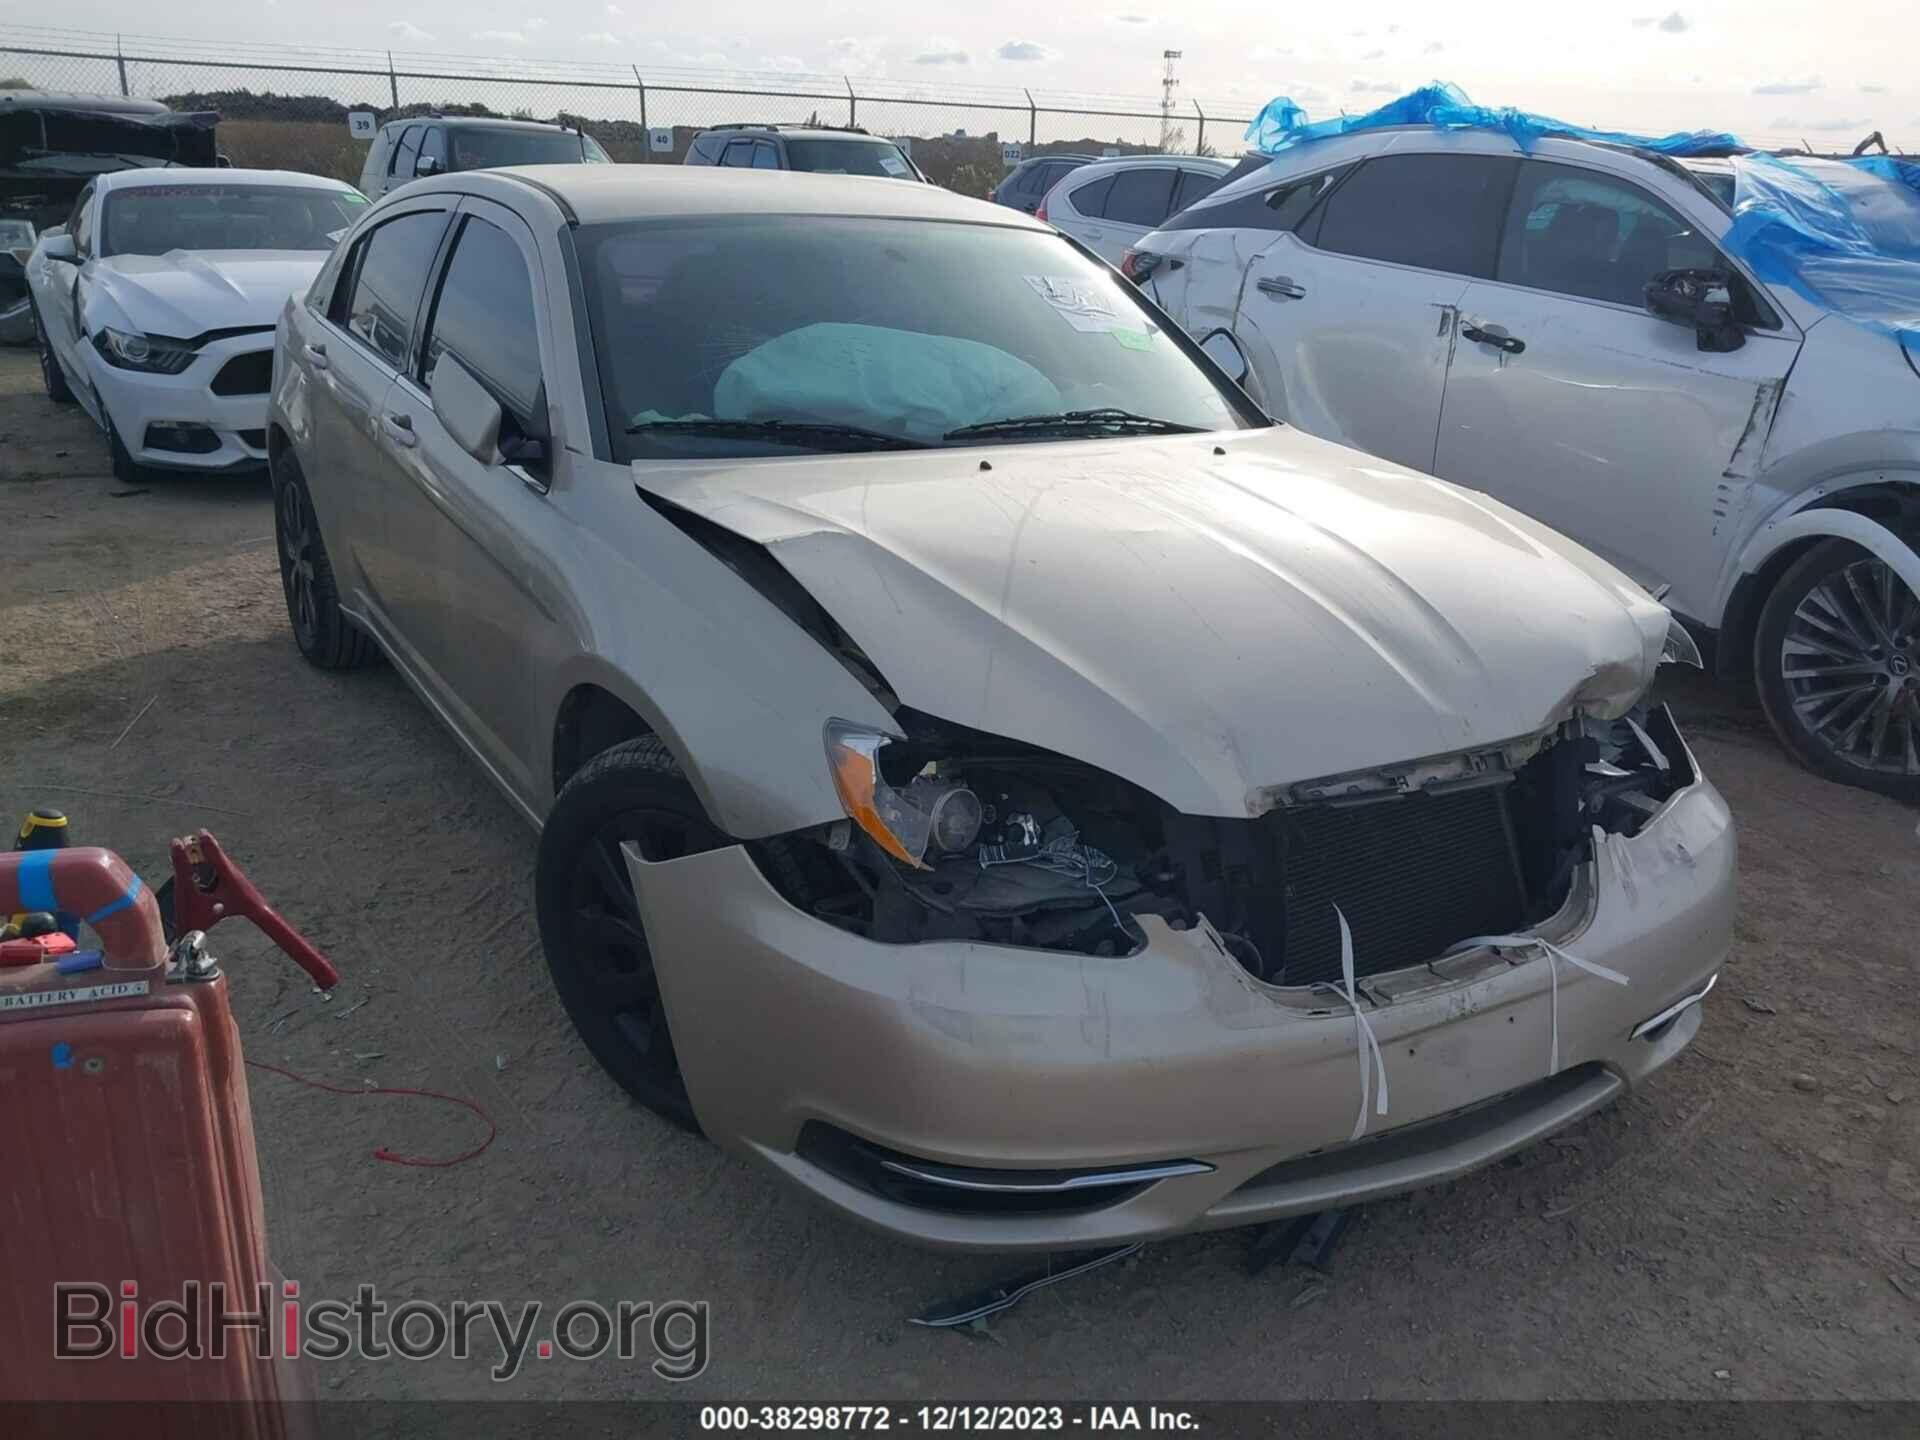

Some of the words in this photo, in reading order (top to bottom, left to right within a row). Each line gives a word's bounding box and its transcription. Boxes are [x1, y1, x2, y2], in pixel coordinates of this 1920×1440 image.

[355, 120, 370, 130] 39
[656, 135, 668, 145] 40
[4, 990, 77, 1007] BATTERY
[89, 984, 128, 1000] ACID
